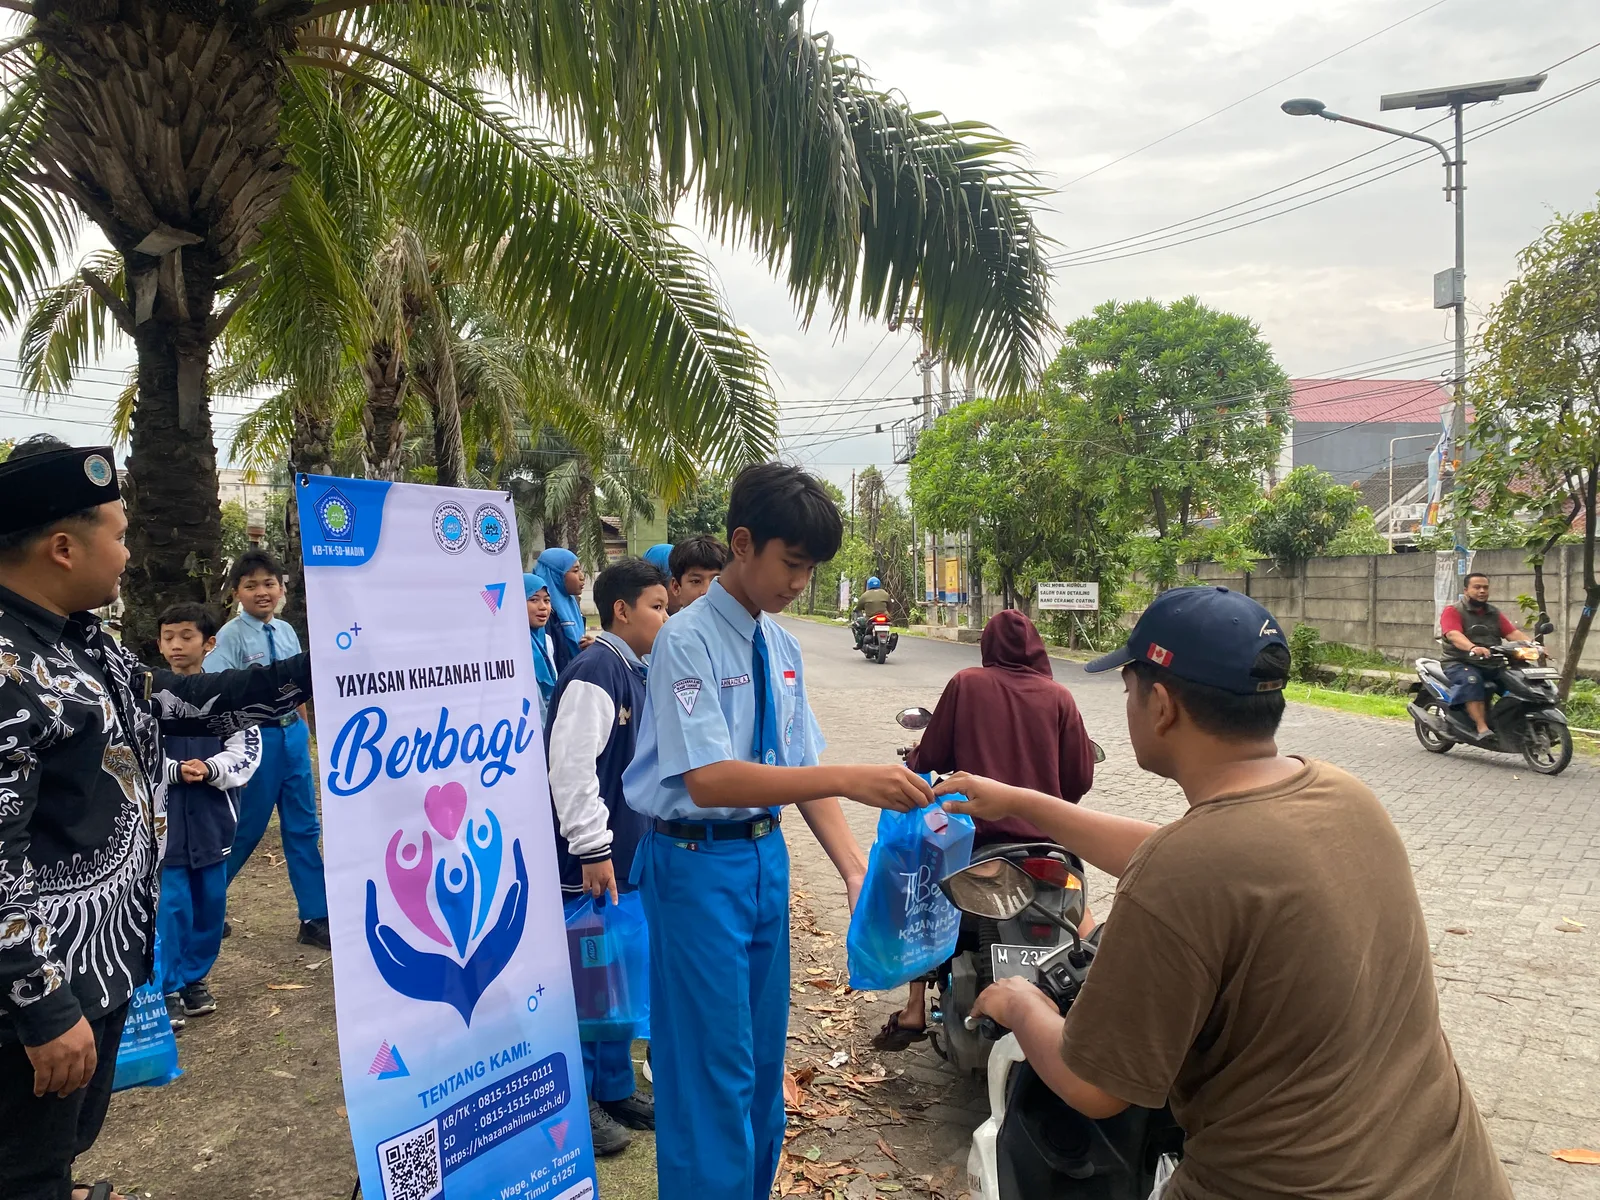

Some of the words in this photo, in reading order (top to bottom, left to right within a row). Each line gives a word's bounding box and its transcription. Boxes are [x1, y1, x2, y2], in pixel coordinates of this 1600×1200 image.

[312, 545, 365, 557] KB-TK-SD-MADIN
[335, 669, 406, 698] YAYASAN
[408, 662, 482, 690] KHAZANAH
[484, 659, 515, 681] ILMU
[684, 696, 693, 706] VI
[327, 698, 534, 797] Berbagi
[997, 948, 1009, 964] M
[417, 1060, 486, 1109] TENTANG
[489, 1041, 532, 1072] KAMI:
[442, 1103, 471, 1131] KB/TK
[478, 1062, 553, 1109] 0815-1515-0111
[443, 1134, 456, 1151] SD
[479, 1080, 555, 1128] 0815-1515-0999
[445, 1091, 565, 1168] https://khazanahilmu.sch.id/
[500, 1180, 529, 1200] Wage,
[530, 1168, 551, 1184] Kec.
[552, 1147, 580, 1169] Taman
[524, 1182, 550, 1200] Timur
[552, 1163, 577, 1186] 61257
